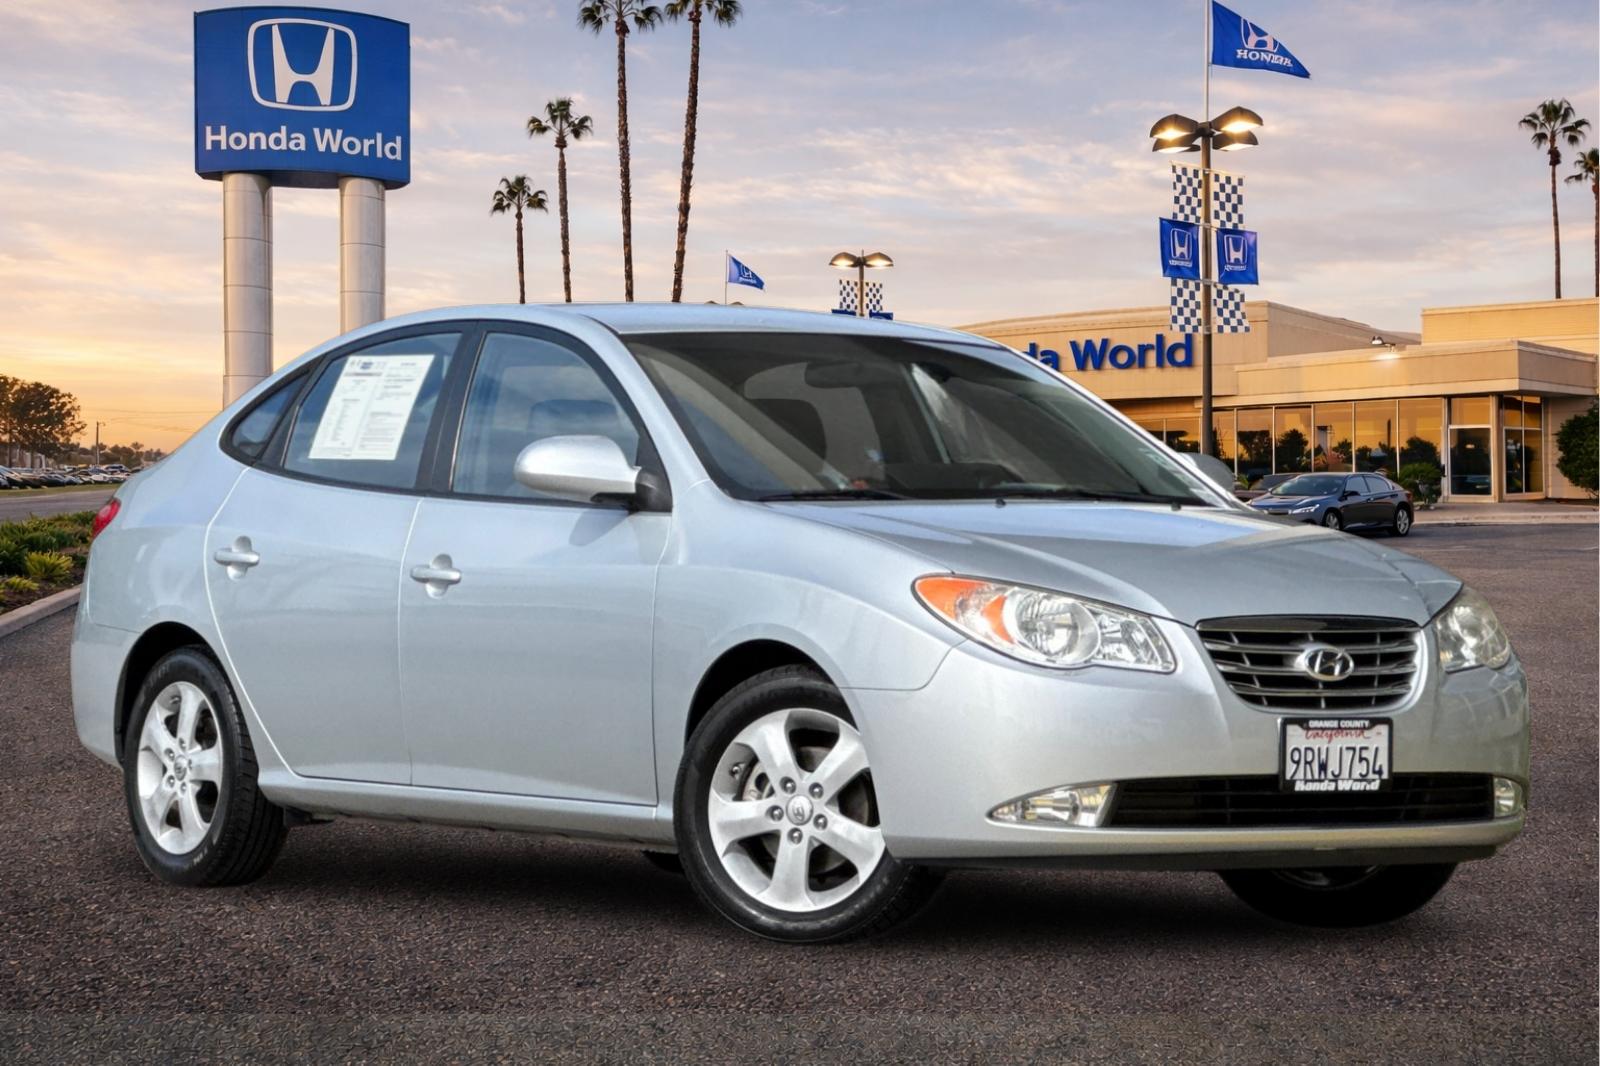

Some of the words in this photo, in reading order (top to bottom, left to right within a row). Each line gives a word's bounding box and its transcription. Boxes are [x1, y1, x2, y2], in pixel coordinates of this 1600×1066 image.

[205, 125, 306, 151] Honda
[313, 127, 402, 161] World
[1069, 333, 1194, 371] World
[1308, 720, 1339, 728] ORANGE
[1340, 720, 1370, 728] COUNTY
[1290, 746, 1384, 780] 9RWJ754
[1294, 779, 1336, 791] Honda
